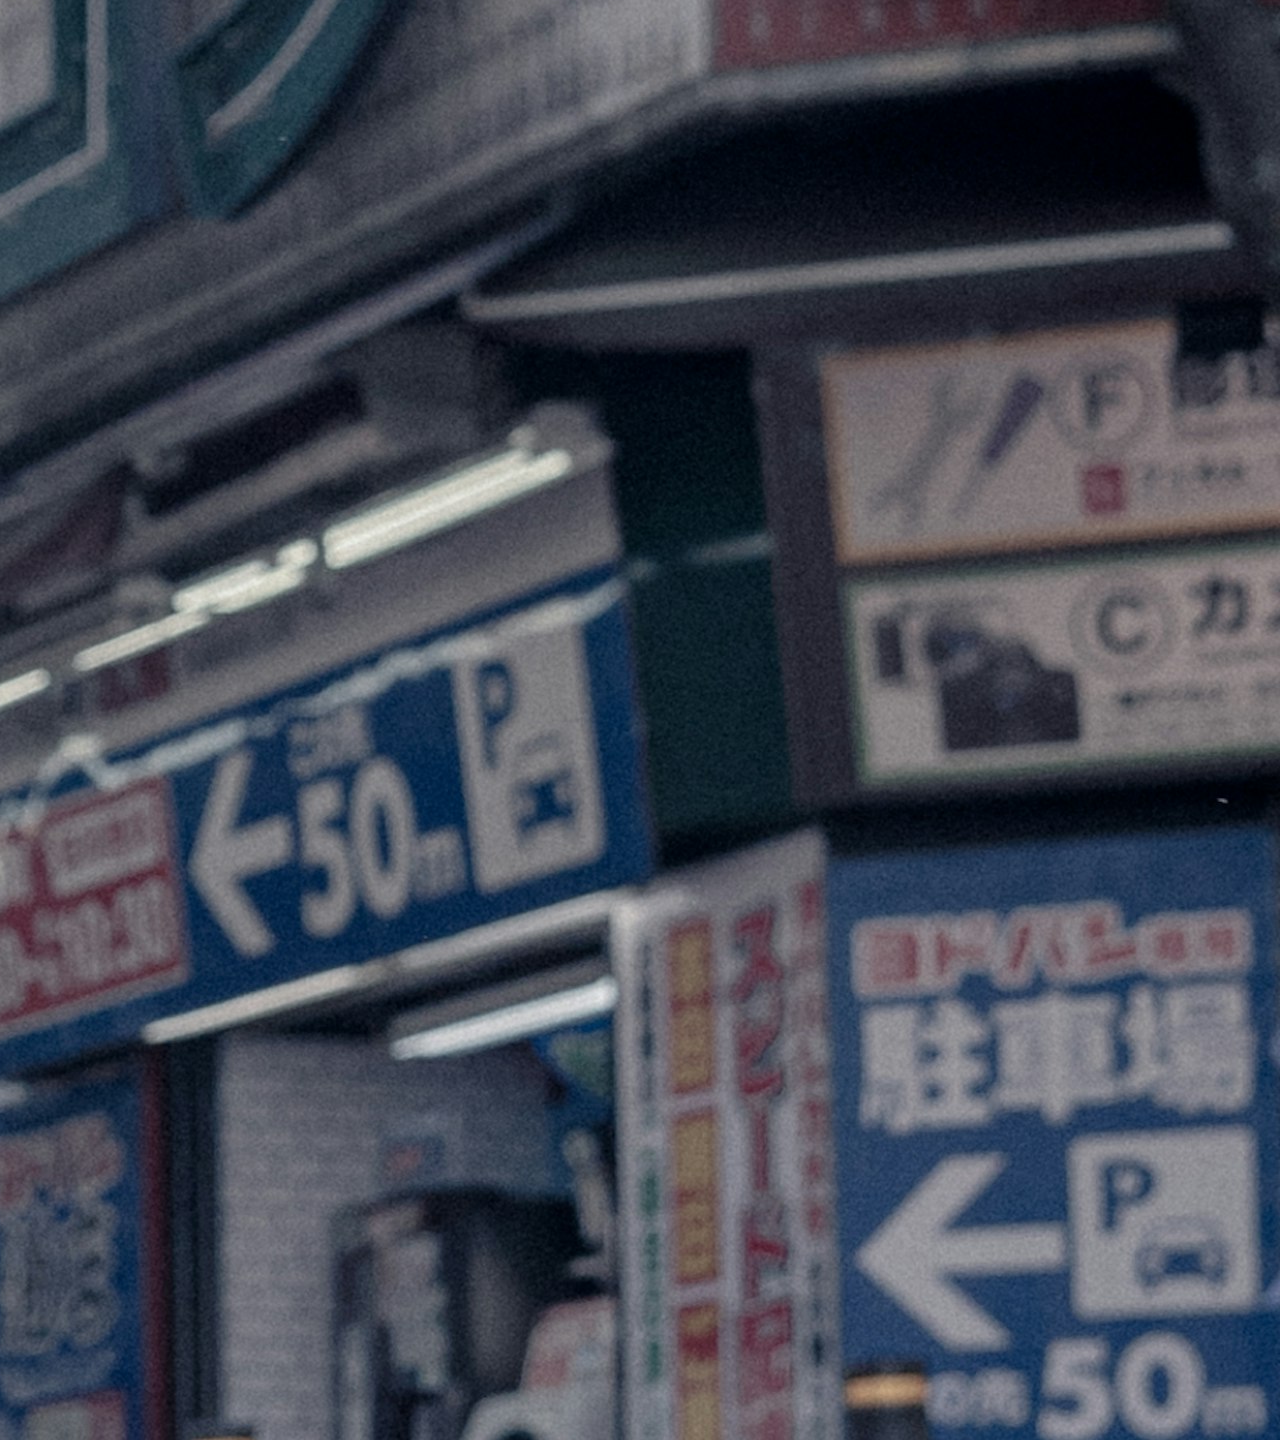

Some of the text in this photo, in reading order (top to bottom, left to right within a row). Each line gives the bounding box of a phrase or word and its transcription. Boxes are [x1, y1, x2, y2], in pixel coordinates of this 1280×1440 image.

[1188, 576, 1280, 636] カ
[296, 756, 466, 938] 50m
[858, 979, 1254, 1133] 駐車場
